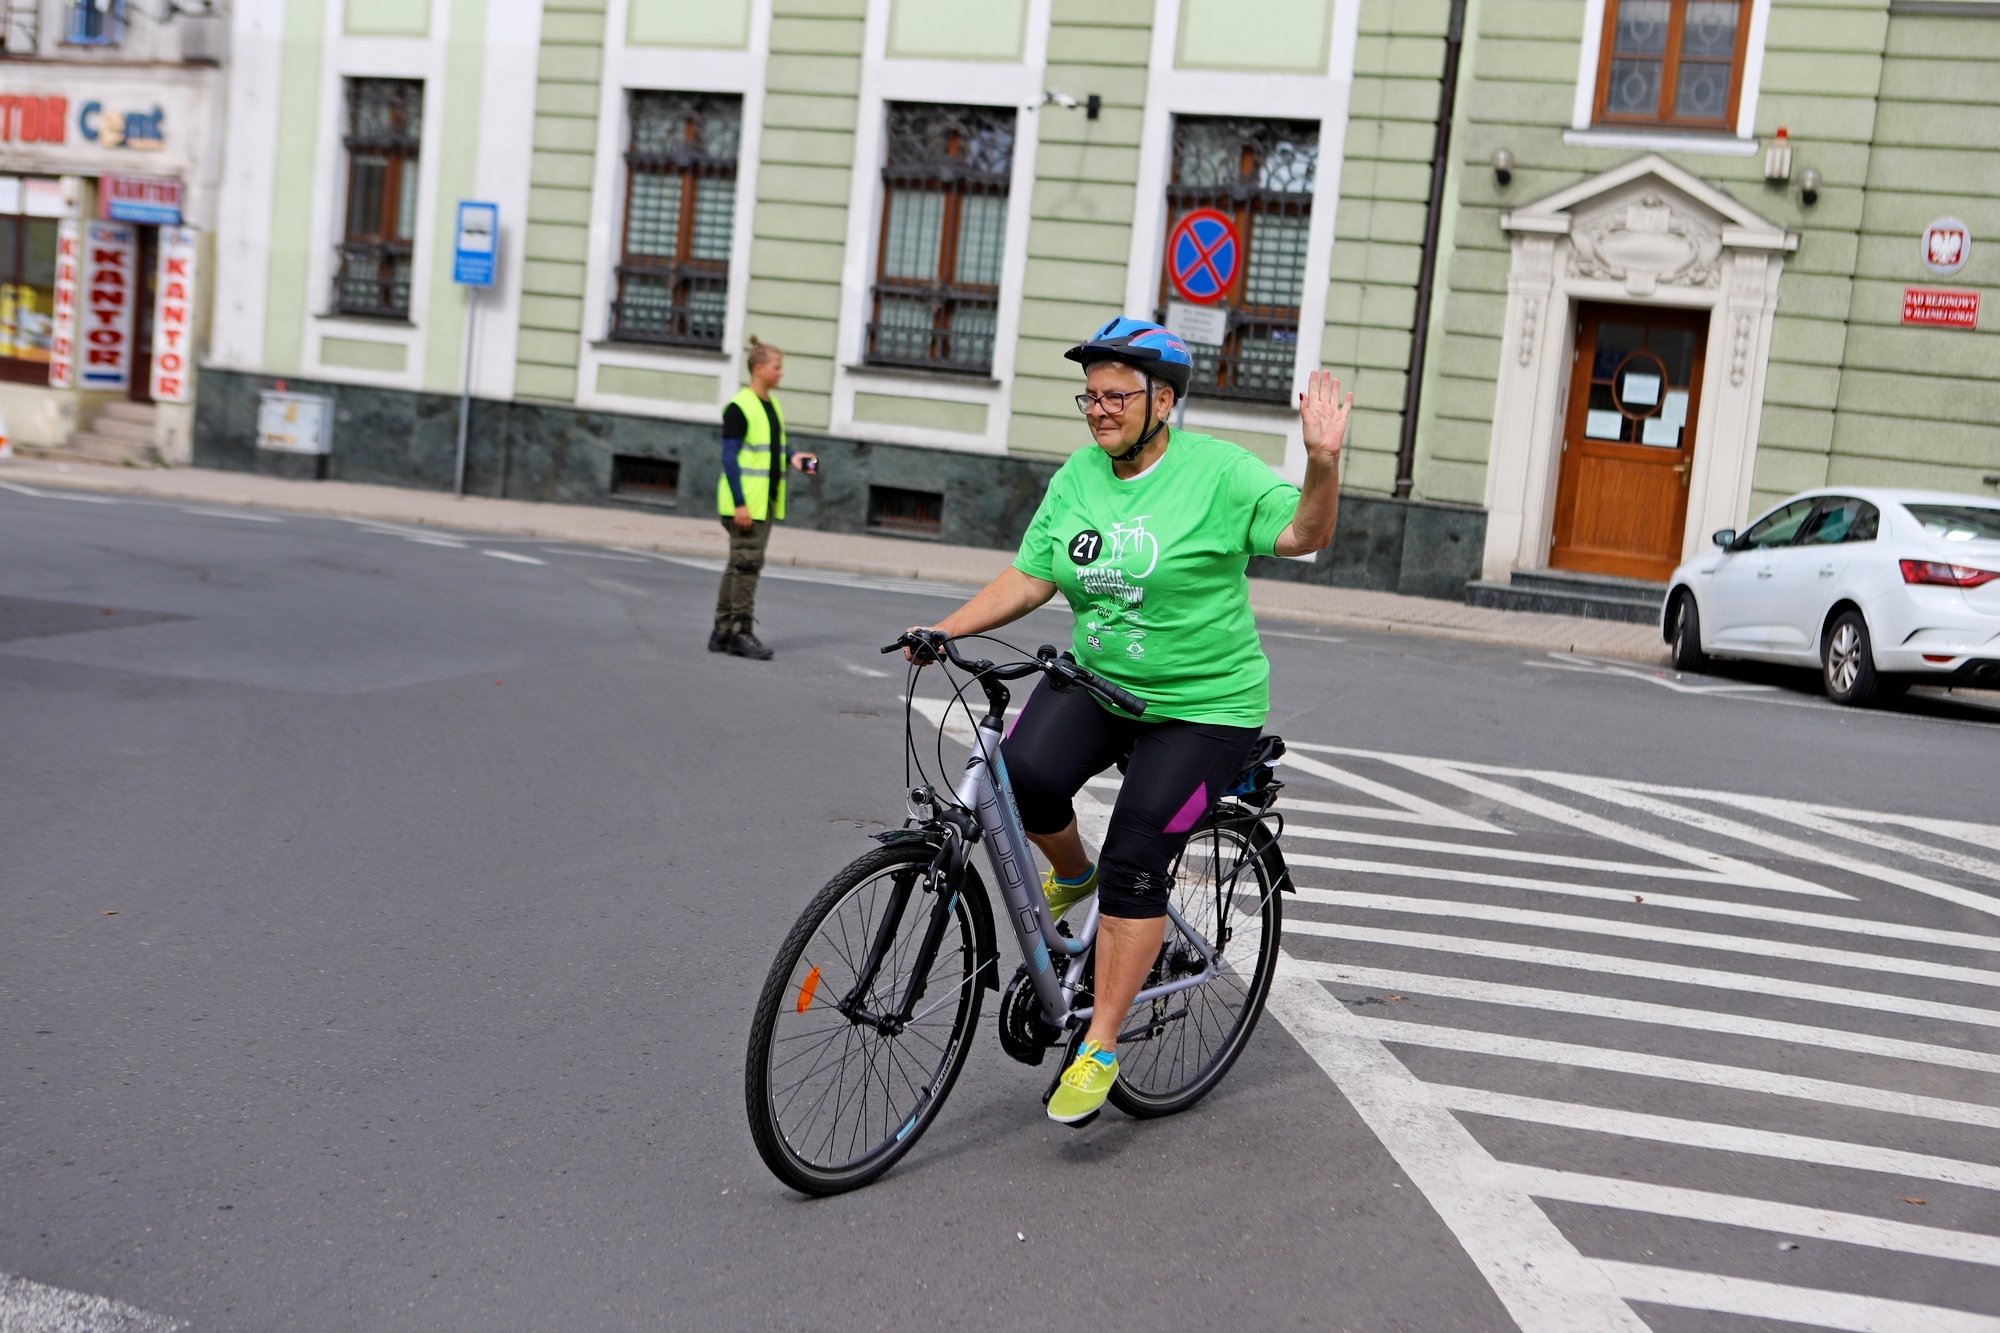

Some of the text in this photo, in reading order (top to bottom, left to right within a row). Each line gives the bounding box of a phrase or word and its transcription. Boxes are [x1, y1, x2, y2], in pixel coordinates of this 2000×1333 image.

[87, 248, 125, 367] KANTOR
[159, 257, 187, 397] KANTOR
[1072, 534, 1099, 559] 21
[1076, 567, 1125, 585] PARADA
